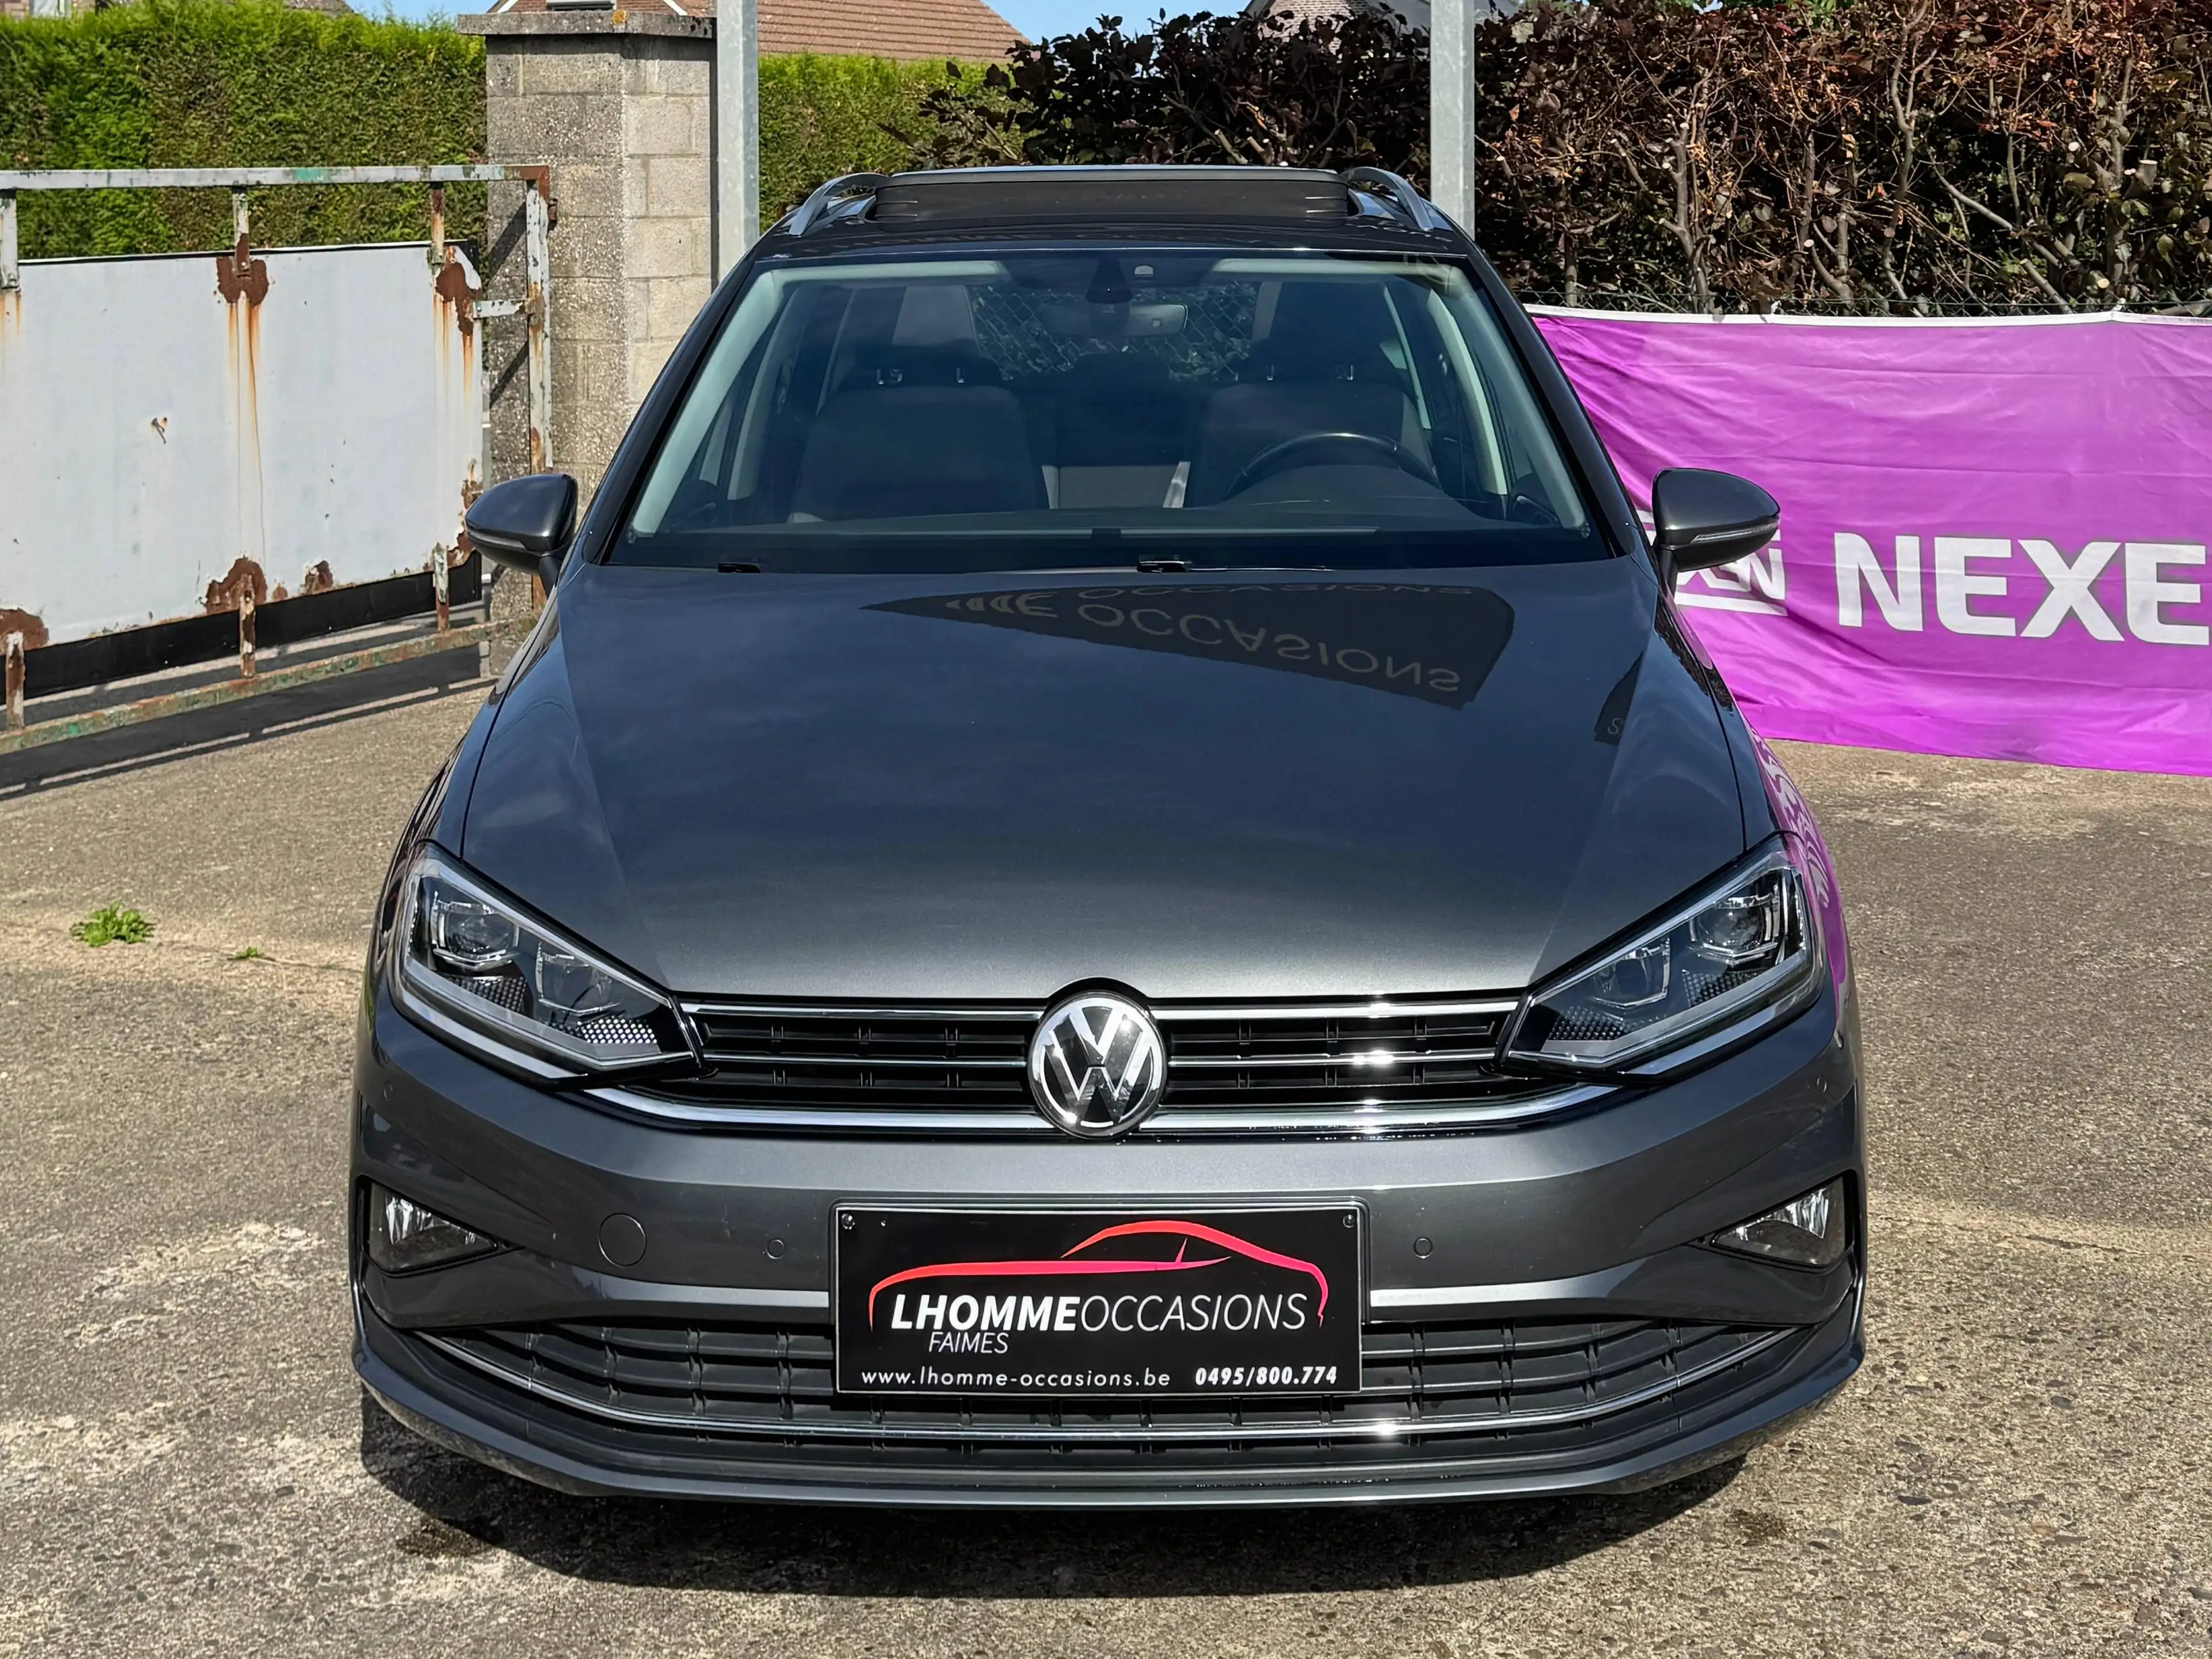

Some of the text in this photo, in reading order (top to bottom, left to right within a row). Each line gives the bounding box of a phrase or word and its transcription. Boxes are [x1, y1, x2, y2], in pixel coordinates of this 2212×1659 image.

[1834, 532, 2210, 646] NEXE
[928, 1331, 1009, 1354] FAIMES
[861, 1366, 1338, 1387] www.lhomme-occasions.be 0495/800.774
